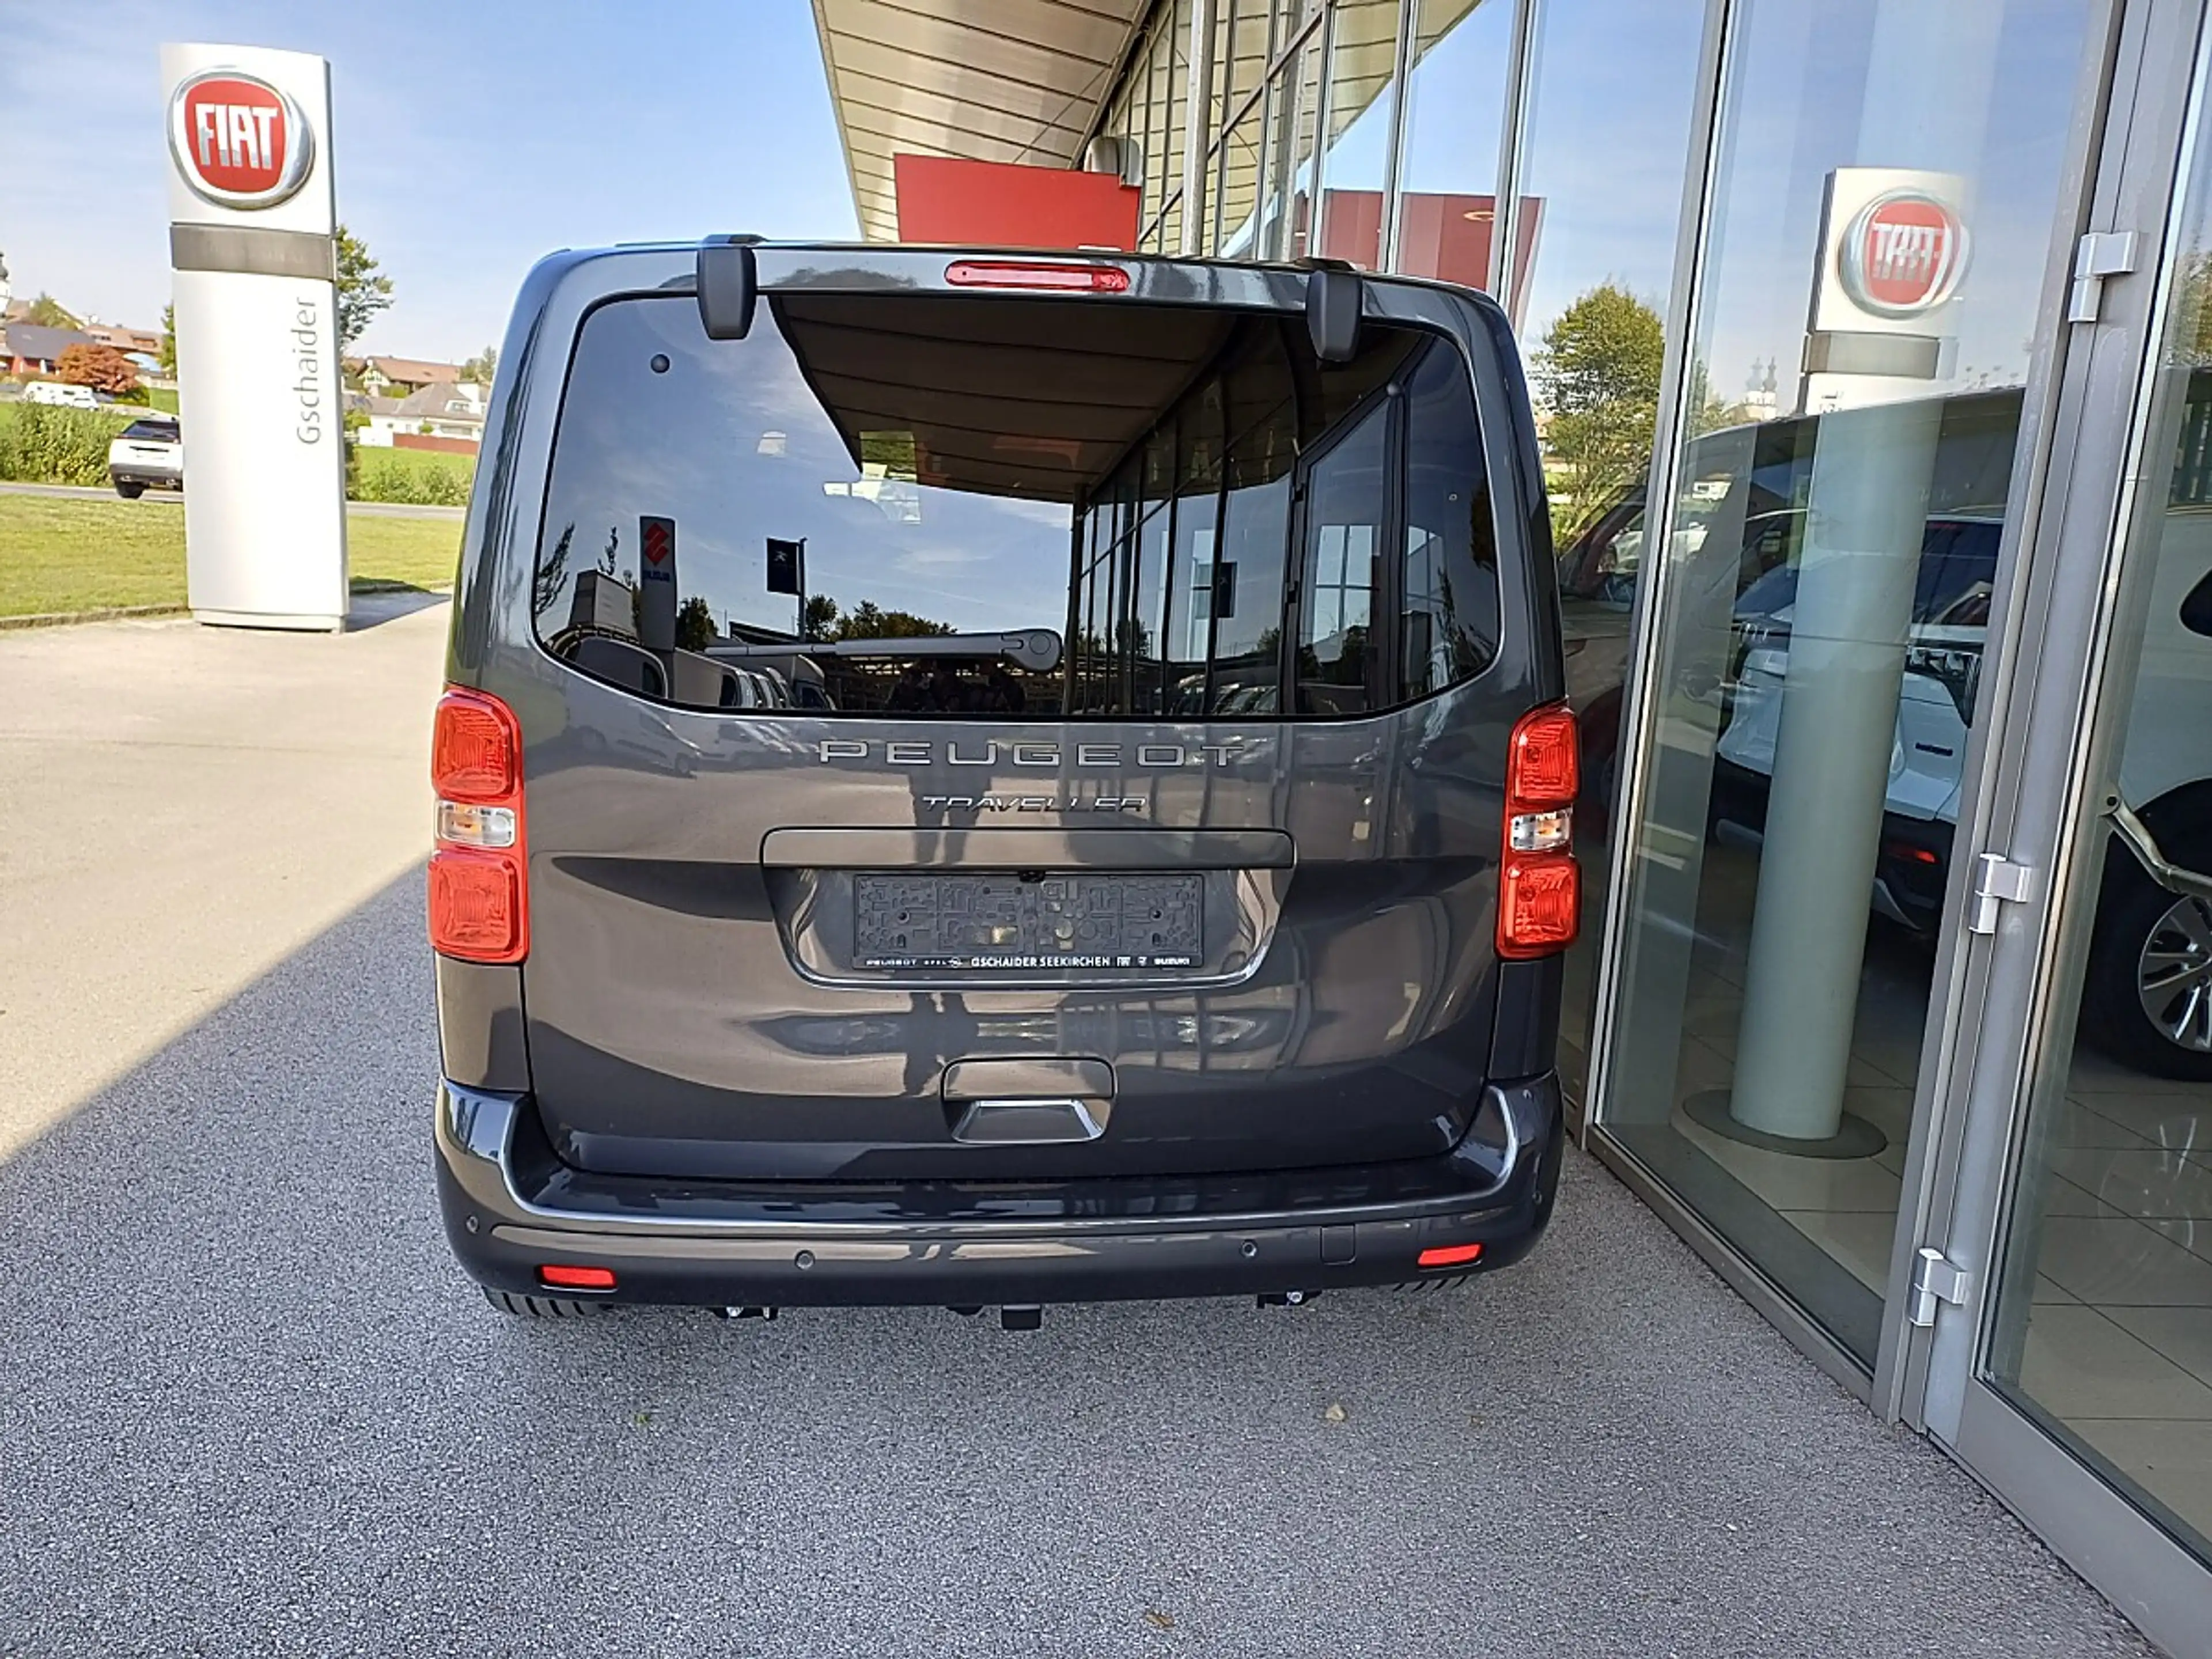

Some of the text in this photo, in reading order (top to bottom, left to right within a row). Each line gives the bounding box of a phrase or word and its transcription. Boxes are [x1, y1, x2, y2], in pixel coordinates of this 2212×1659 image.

[195, 103, 279, 170] FIAT
[291, 297, 320, 446] Gschaider
[819, 740, 1244, 767] PEUGEOT
[923, 796, 1146, 812] TRAVELLER
[971, 956, 1036, 967] GSCHAIDER
[1039, 956, 1110, 967] SEEKIRCHEN
